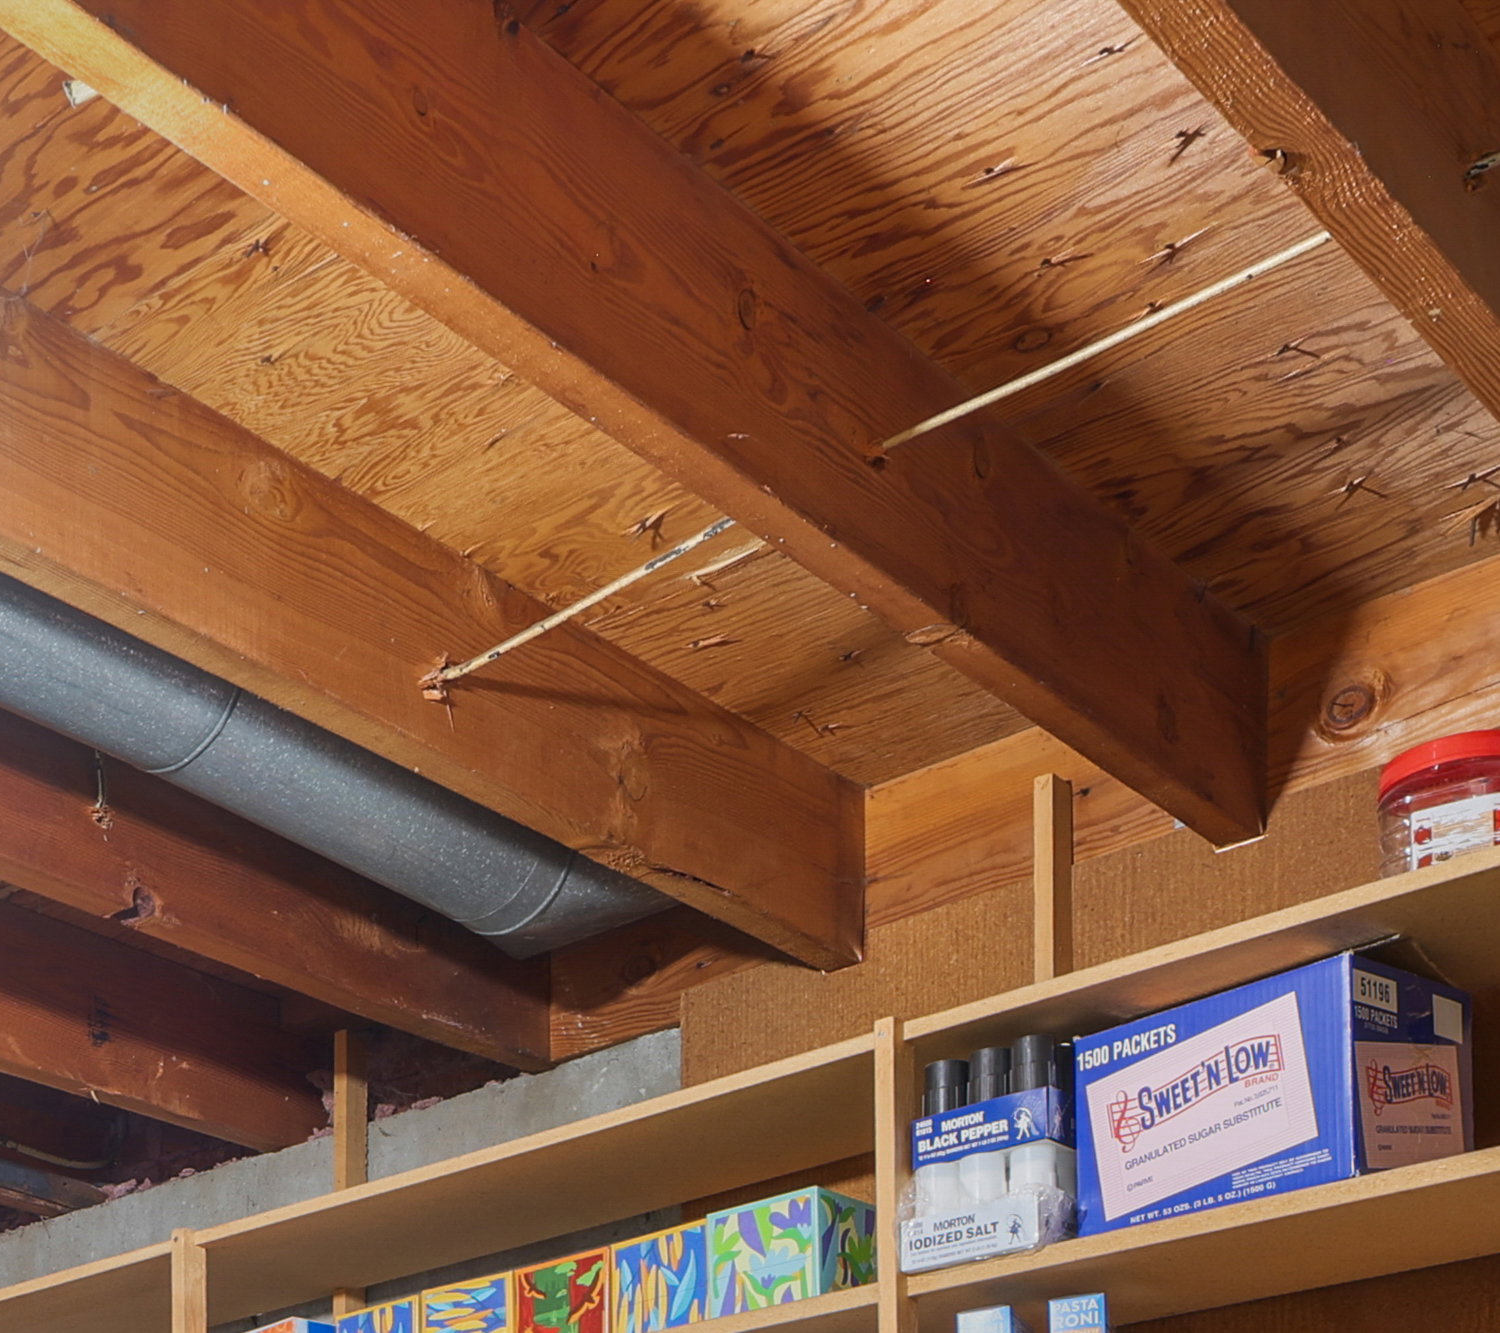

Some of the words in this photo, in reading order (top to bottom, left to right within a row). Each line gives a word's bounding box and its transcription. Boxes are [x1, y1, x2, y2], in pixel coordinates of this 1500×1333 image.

[1359, 978, 1390, 1005] 51196
[1370, 1008, 1398, 1029] PACKETS
[1077, 1043, 1109, 1072] 1500
[1113, 1024, 1176, 1059] PACKETS
[1223, 1040, 1271, 1083] LOW
[1244, 1073, 1279, 1089] BRAND
[941, 1111, 984, 1132] MORTON
[1125, 1137, 1187, 1171] GRANULATED
[1187, 1123, 1221, 1145] SUGAR
[1223, 1098, 1282, 1129] SUBSTITUTE
[918, 1132, 958, 1153] BLACK
[961, 1119, 1008, 1142] PEPPER
[909, 1229, 963, 1251] IODIZED
[966, 1222, 999, 1238] SALT
[933, 1214, 976, 1232] MORTON
